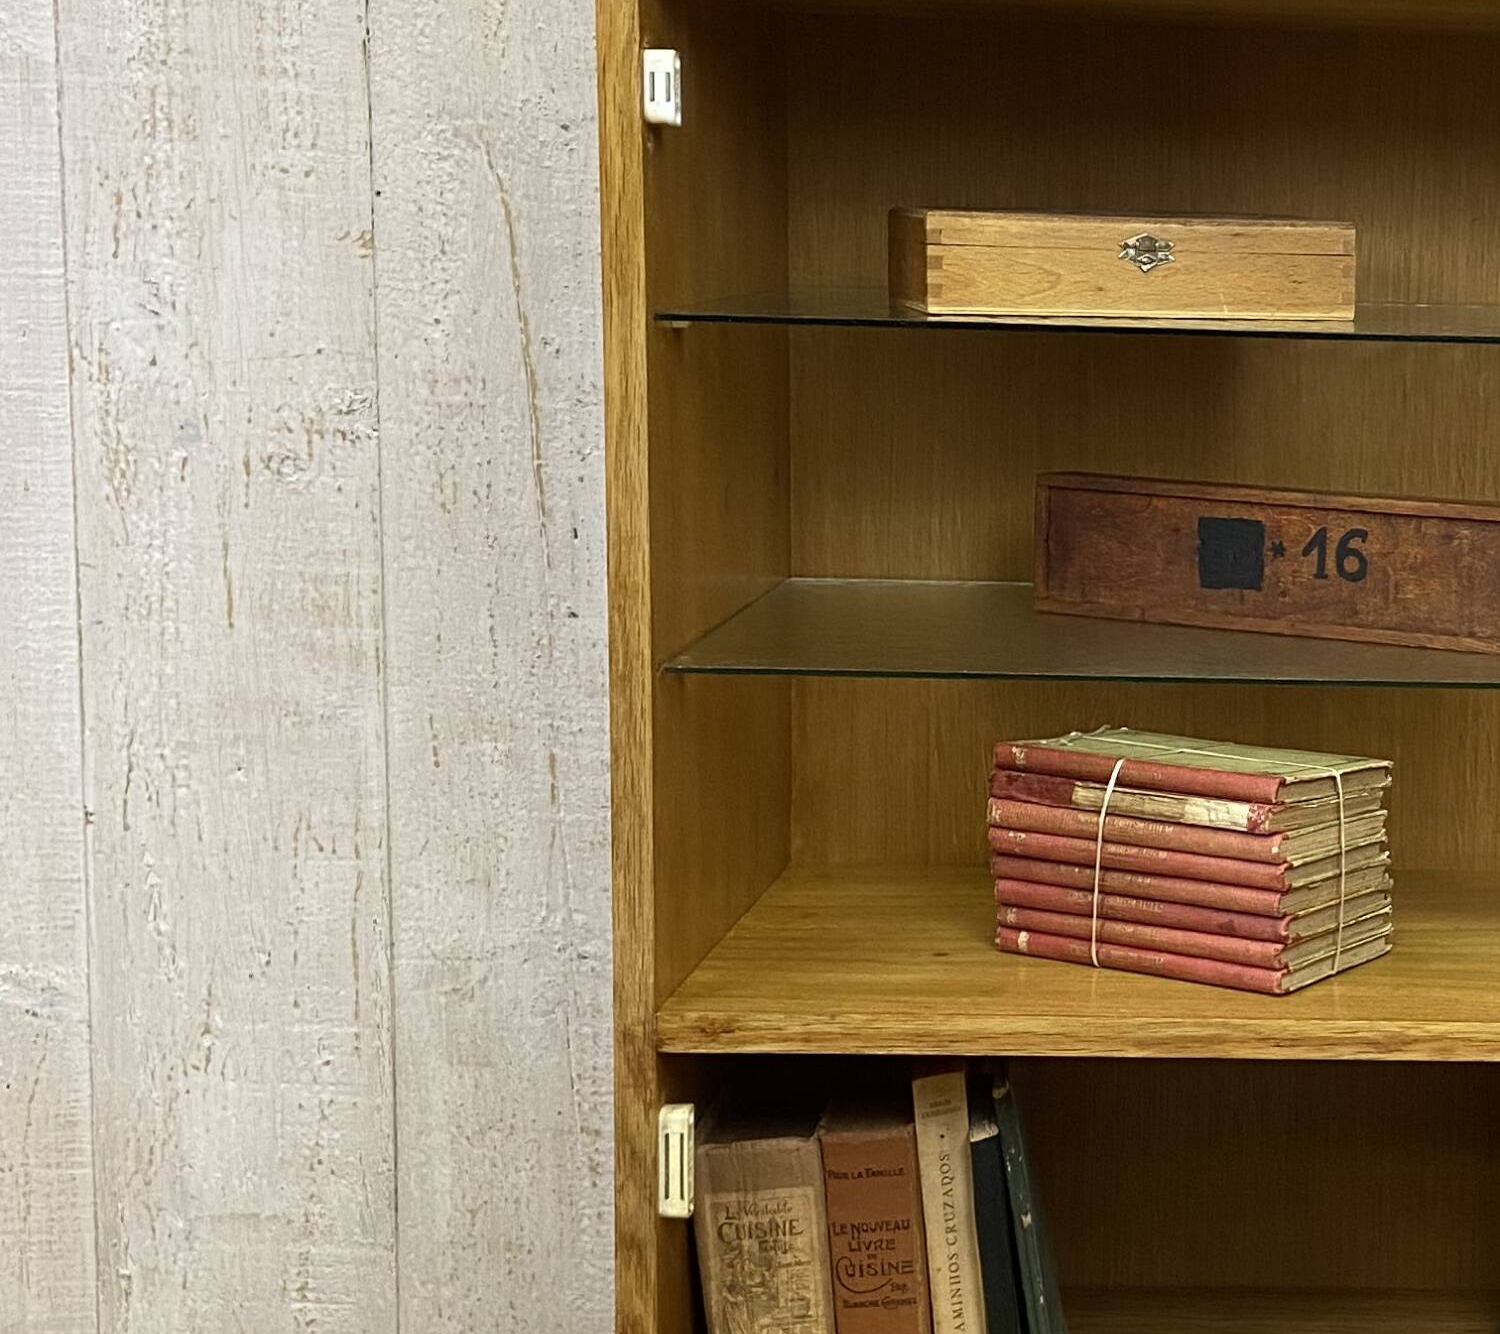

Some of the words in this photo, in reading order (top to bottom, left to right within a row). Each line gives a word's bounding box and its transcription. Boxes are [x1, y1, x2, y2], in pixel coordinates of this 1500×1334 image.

[1302, 526, 1368, 582] 16
[851, 1171, 864, 1179] LA
[939, 1153, 958, 1245] CRUZADOS
[717, 1218, 804, 1244] CUISINE
[832, 1222, 848, 1236] LE
[850, 1219, 910, 1240] NOUVEAU
[848, 1238, 896, 1252] LIVRE
[836, 1256, 915, 1294] CUISINE
